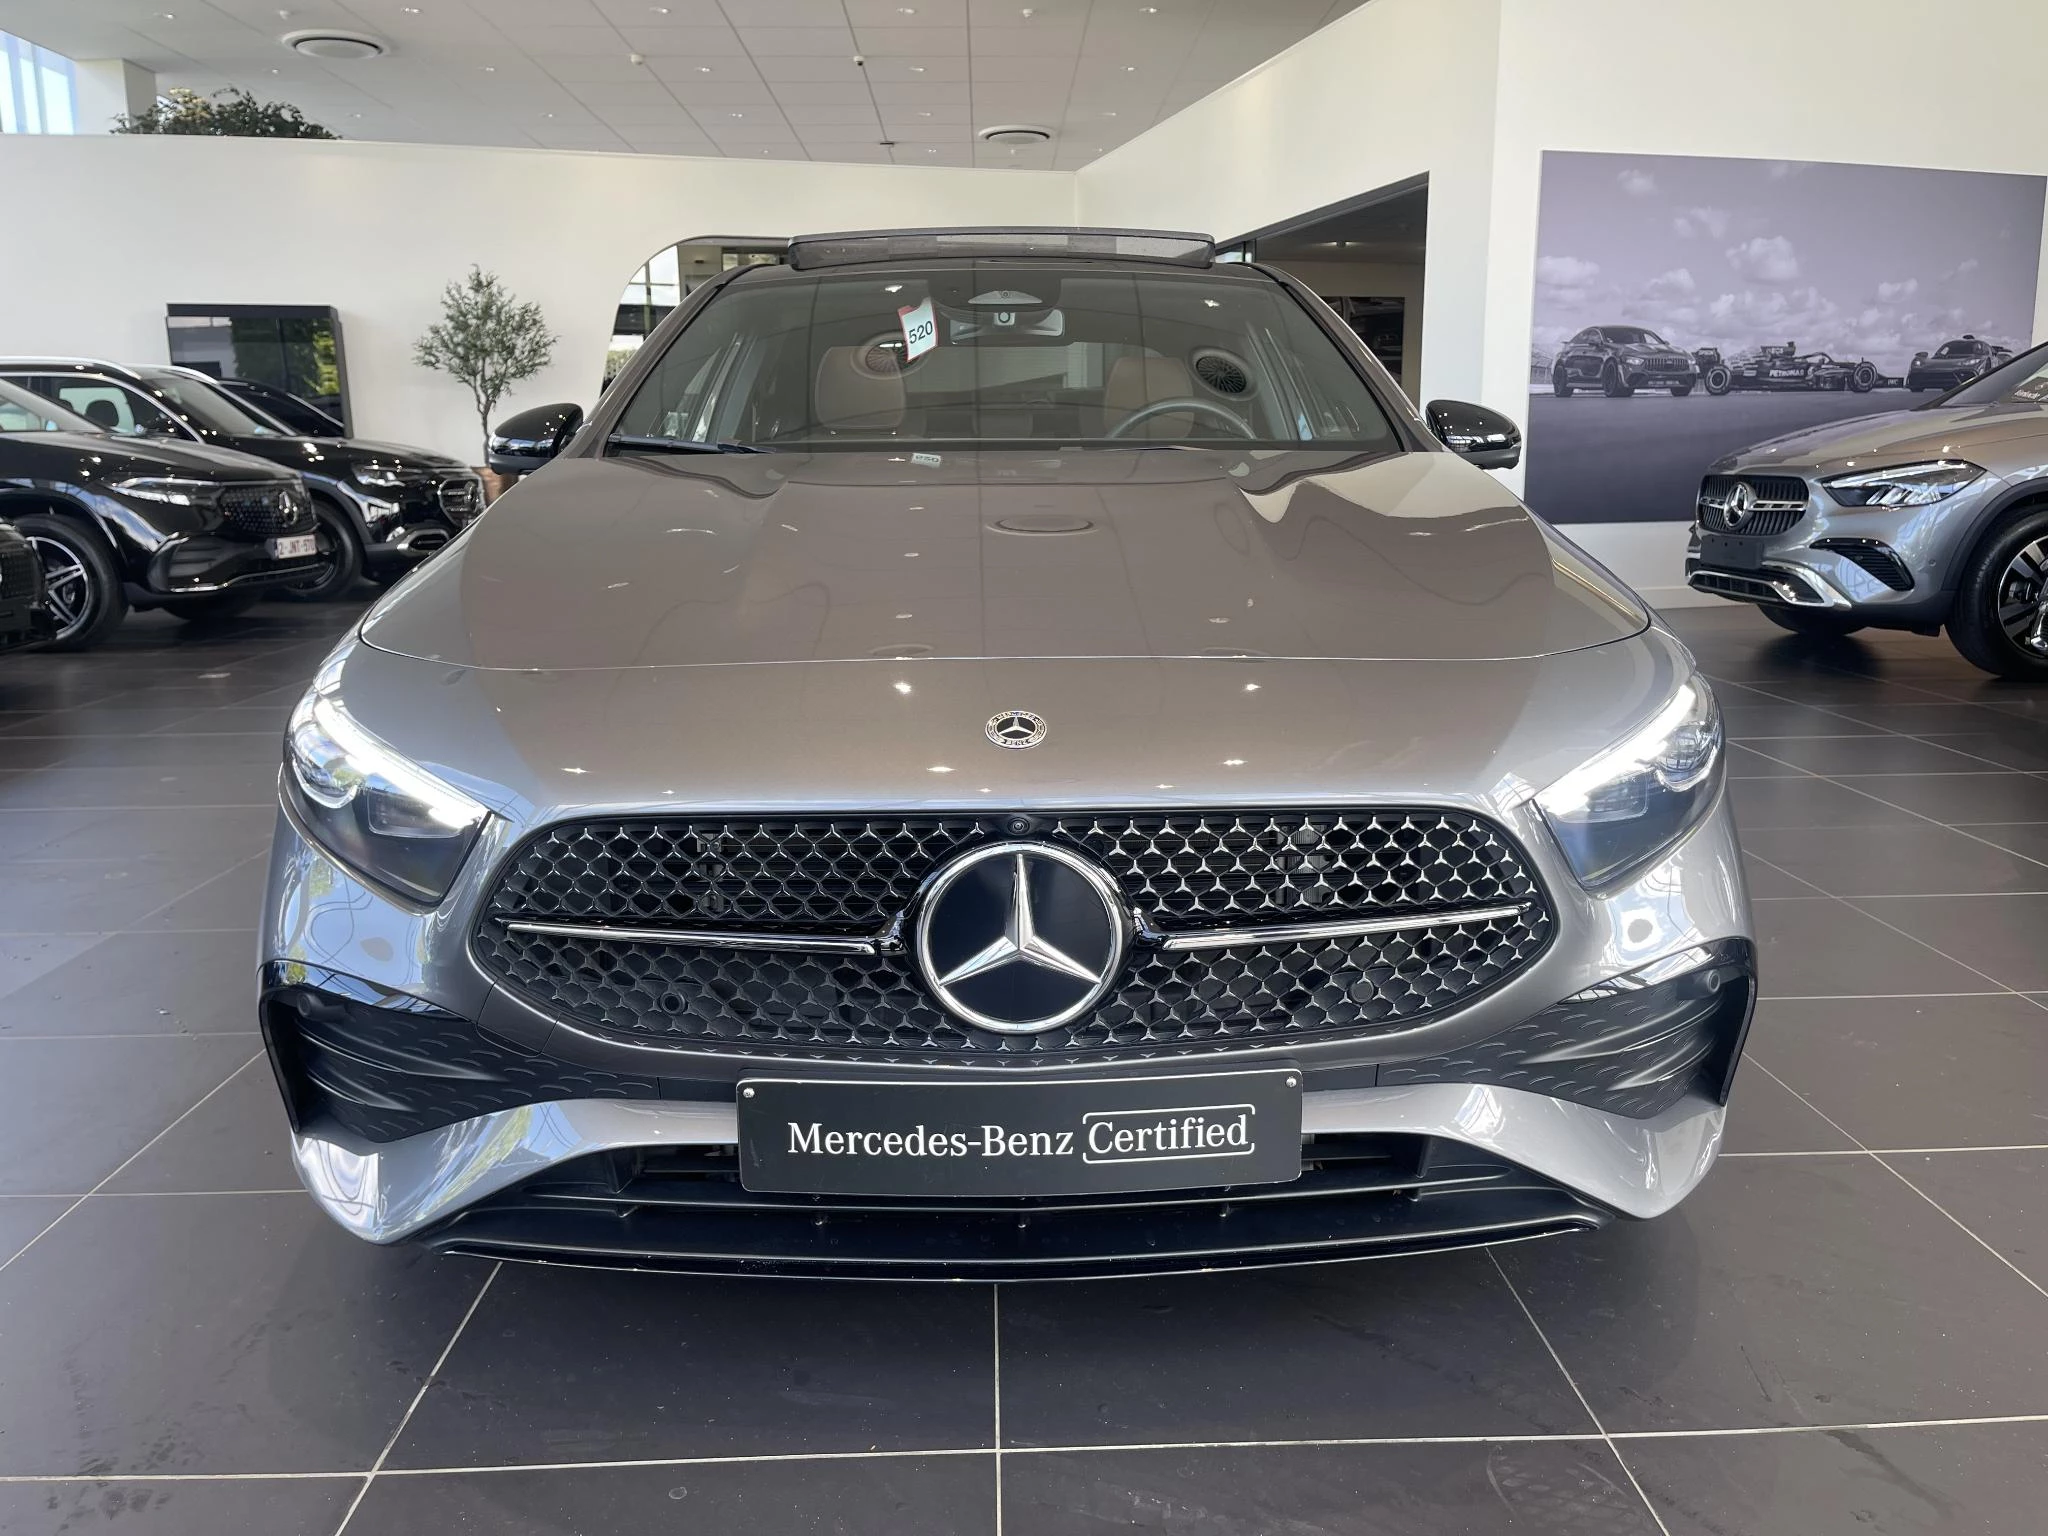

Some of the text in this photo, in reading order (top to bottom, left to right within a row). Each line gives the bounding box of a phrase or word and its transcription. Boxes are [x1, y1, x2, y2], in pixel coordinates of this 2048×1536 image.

[908, 320, 933, 344] 520
[1768, 368, 1805, 378] PETRONAS
[787, 1113, 1249, 1158] Mercedes-Benz Certified
